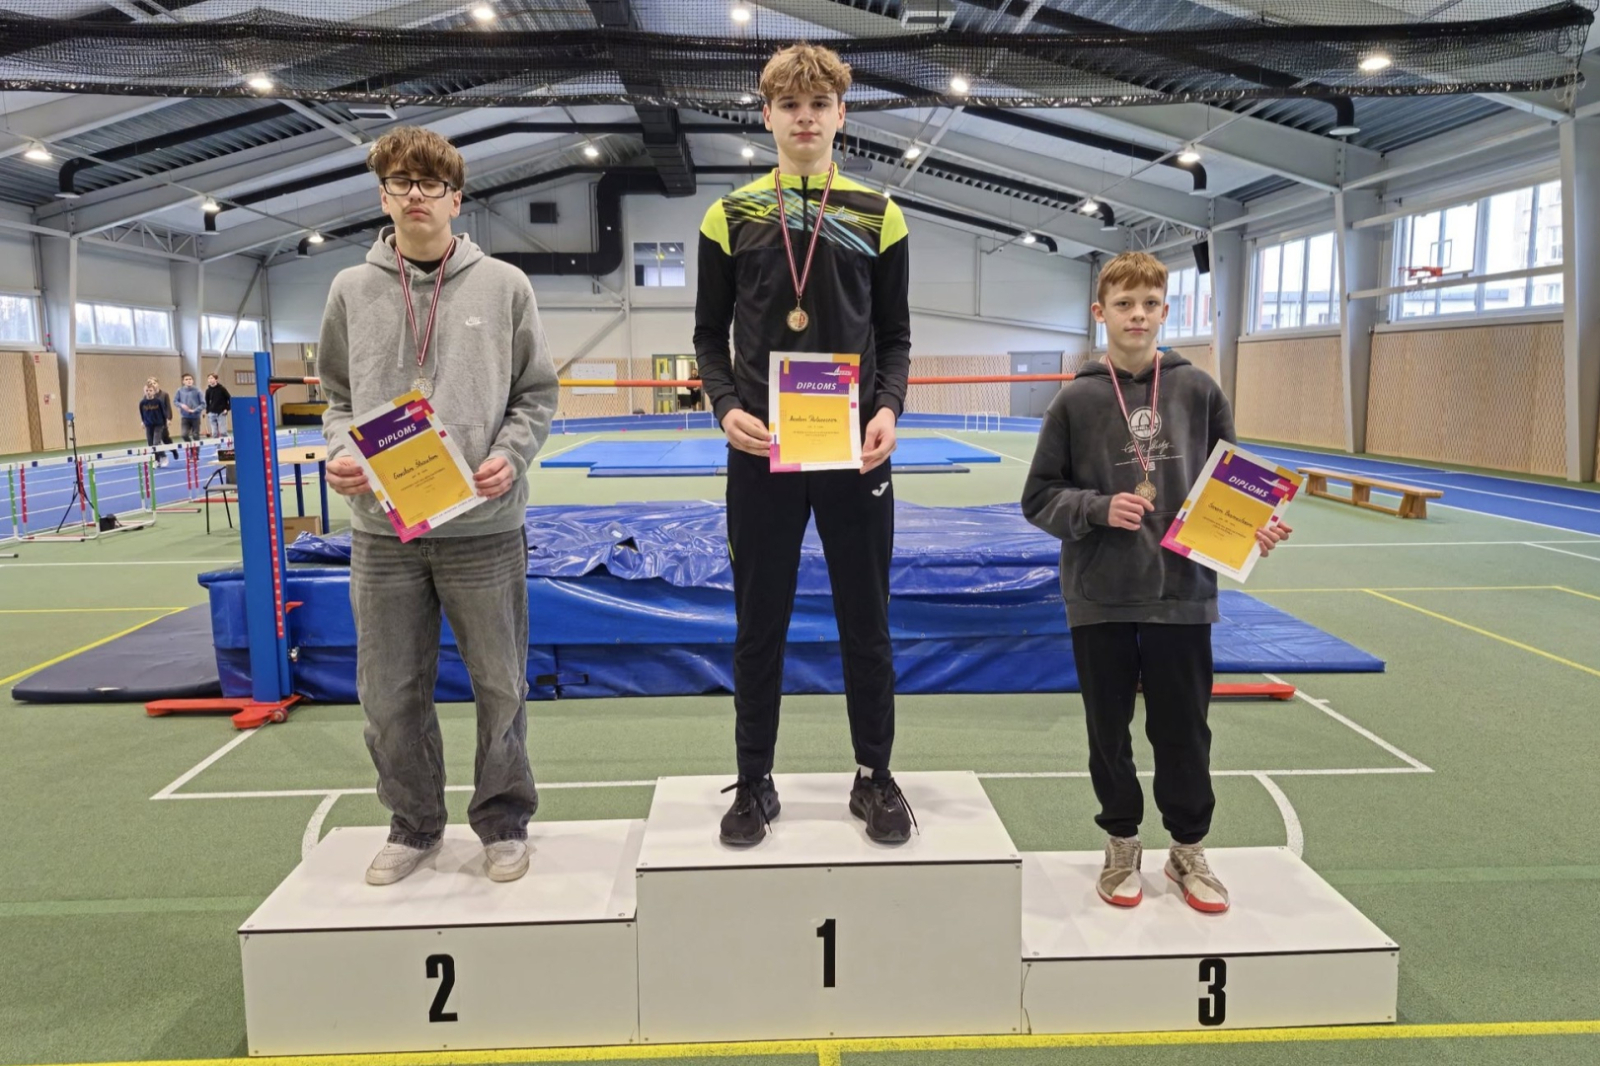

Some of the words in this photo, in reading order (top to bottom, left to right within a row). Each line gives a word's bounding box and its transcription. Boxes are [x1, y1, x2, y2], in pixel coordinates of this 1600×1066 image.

[796, 382, 837, 391] DIPLOMS
[378, 423, 417, 448] DIPLOMS
[1228, 475, 1269, 498] DIPLOMS
[817, 919, 836, 987] 1
[426, 954, 458, 1022] 2
[1198, 959, 1226, 1026] 3
